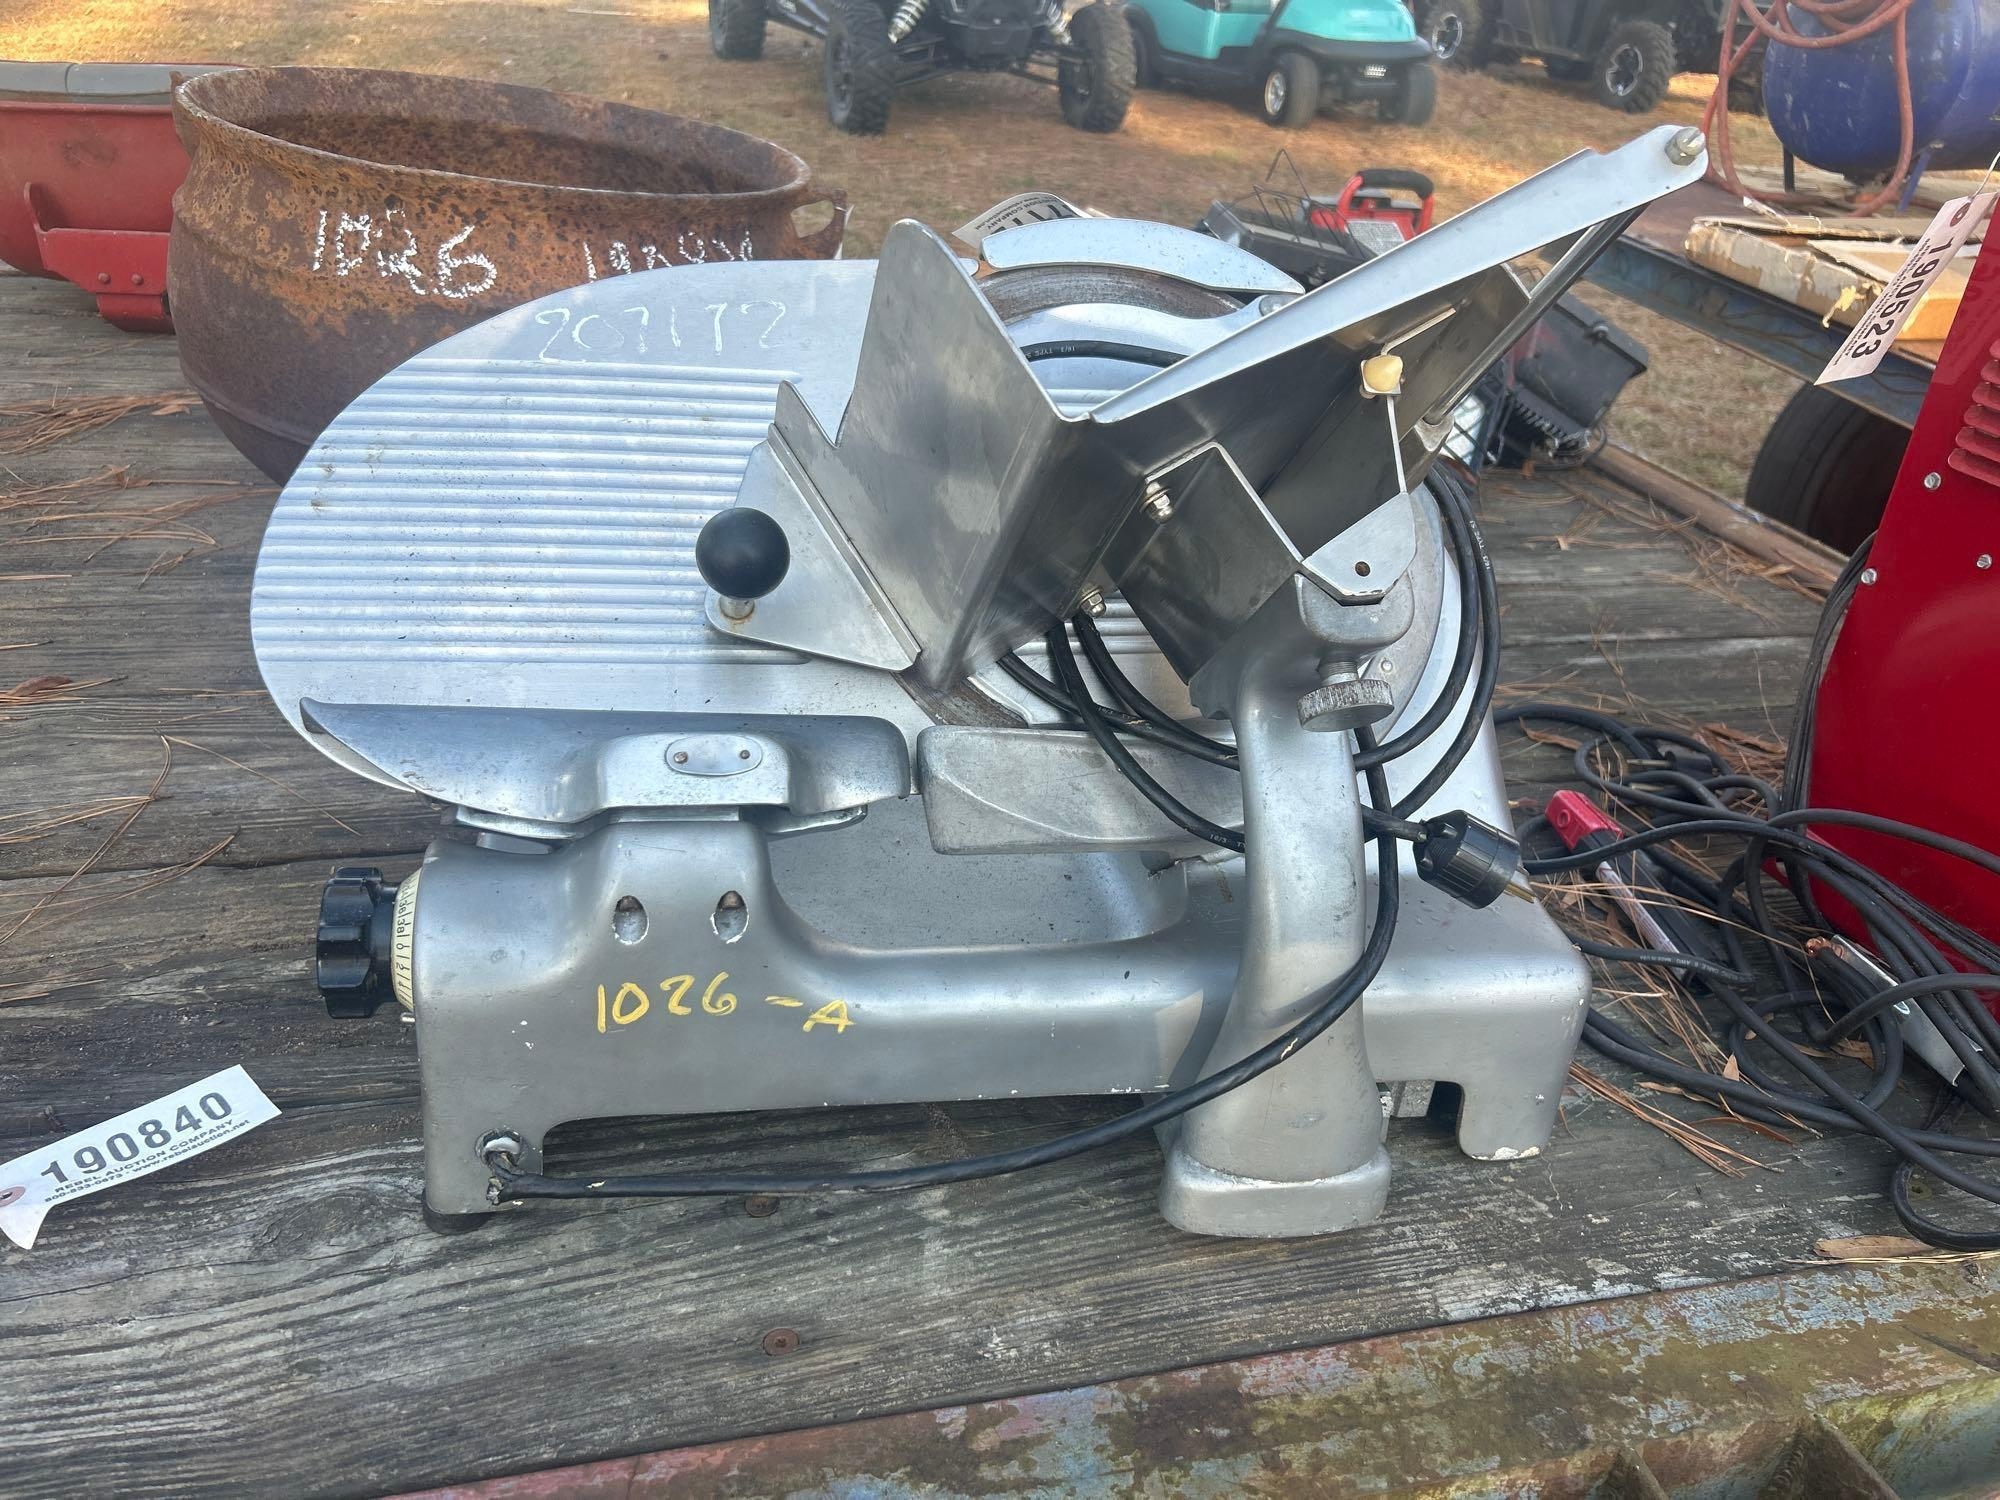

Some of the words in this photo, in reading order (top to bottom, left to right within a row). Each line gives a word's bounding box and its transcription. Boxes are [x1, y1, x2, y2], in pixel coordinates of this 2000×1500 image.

[1851, 237, 1954, 360] 190523
[598, 971, 738, 1035] 1026
[40, 1091, 233, 1184] 190840
[54, 1175, 102, 1193] REBEL
[105, 1150, 167, 1176] AUCTION
[169, 1118, 234, 1152] COMPANY
